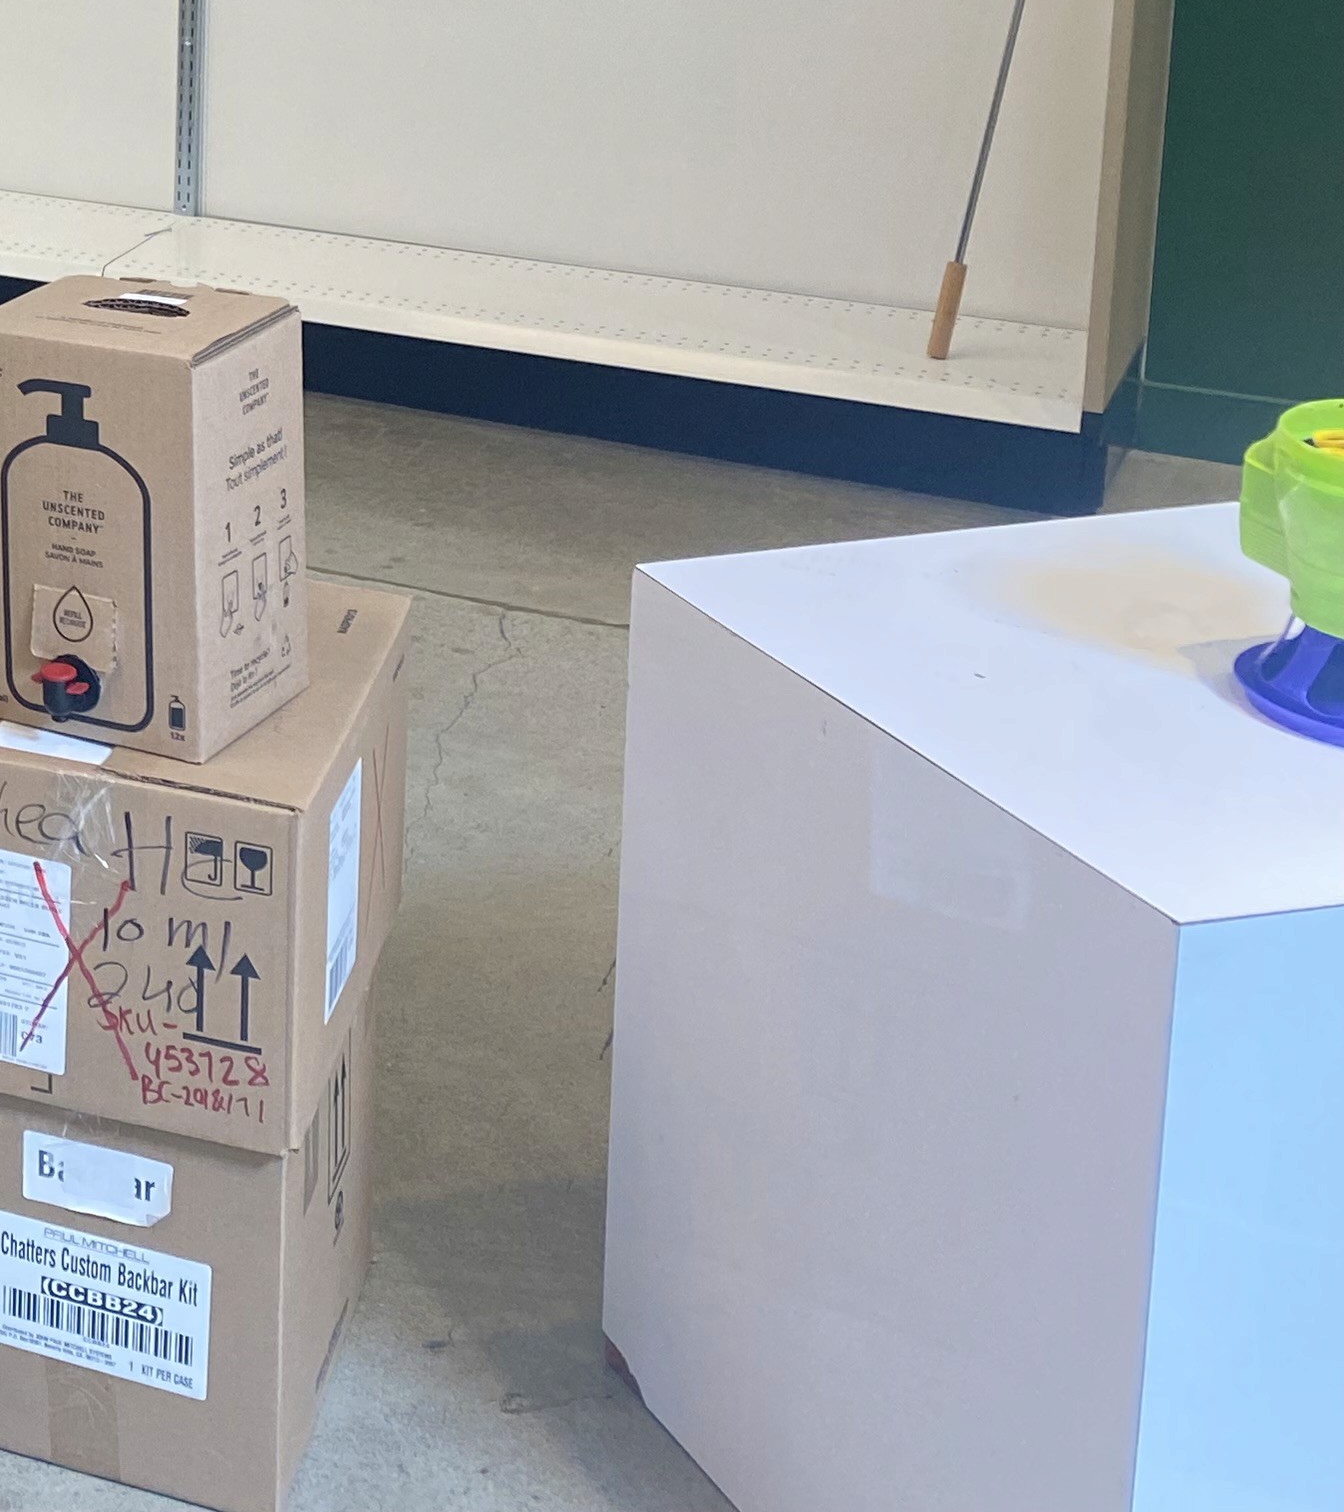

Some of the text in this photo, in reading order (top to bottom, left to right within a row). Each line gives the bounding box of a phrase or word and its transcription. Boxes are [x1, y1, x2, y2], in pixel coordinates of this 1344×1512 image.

[228, 445, 255, 470] Simple
[256, 440, 266, 453] as
[225, 471, 243, 491] Tout
[243, 448, 283, 480] simplement
[63, 490, 84, 503] THE
[280, 488, 287, 509] 3
[42, 500, 105, 521] UNSCENTED
[253, 505, 261, 527] 2
[48, 516, 102, 534] COMPANY
[224, 521, 231, 543] 1
[45, 551, 70, 564] SAVON
[79, 557, 104, 569] MAINS
[52, 543, 96, 558] HAND SOAP
[44, 1227, 150, 1265] PAUL MITCHELL
[1, 1230, 198, 1307] Chatters Custom Backbar Kit
[41, 1275, 164, 1328] (CCBB24)
[128, 1361, 193, 1389] 1 KIT PER CASE
